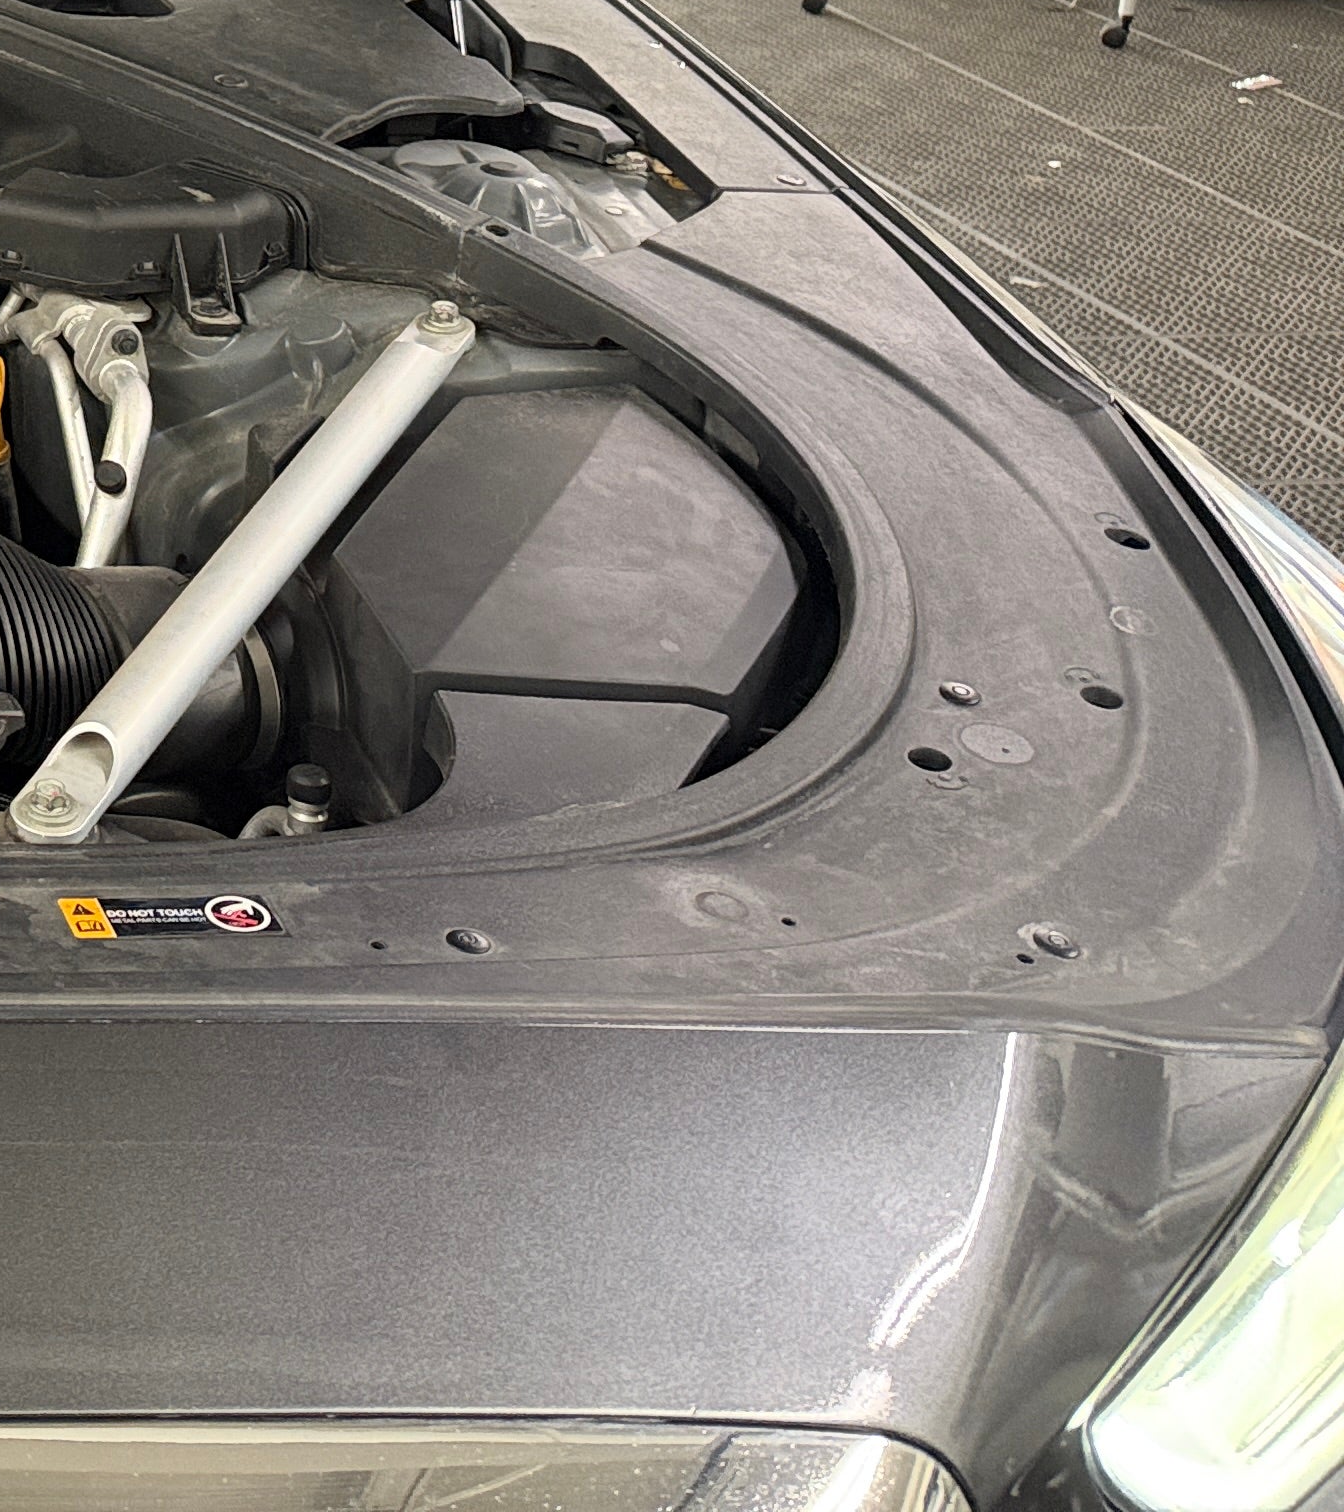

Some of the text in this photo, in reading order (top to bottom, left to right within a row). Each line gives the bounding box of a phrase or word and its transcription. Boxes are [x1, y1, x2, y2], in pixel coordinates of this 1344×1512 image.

[105, 908, 204, 918] DO NOT TOUCH
